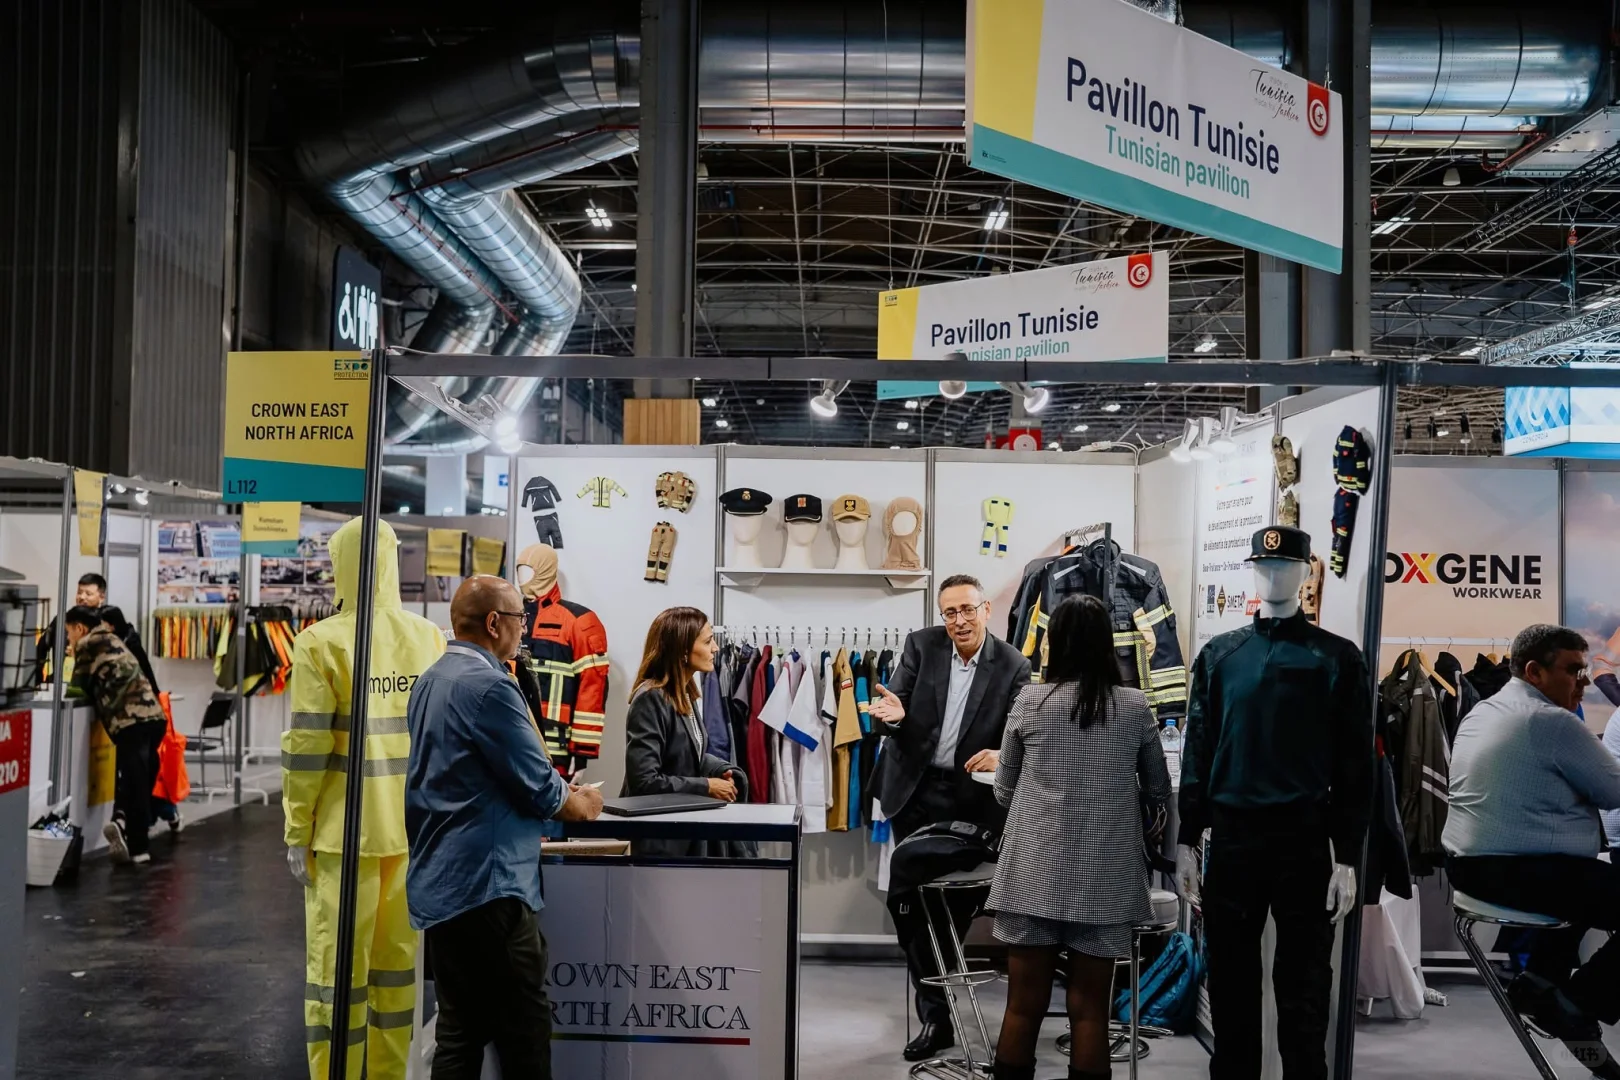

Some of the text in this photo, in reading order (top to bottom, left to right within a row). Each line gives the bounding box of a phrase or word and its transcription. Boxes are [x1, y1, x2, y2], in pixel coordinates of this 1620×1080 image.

[1249, 69, 1296, 107] Tunisia
[1066, 56, 1280, 175] Pavillon Tunisie
[1105, 124, 1250, 199] Tunisian pavilion
[1070, 267, 1116, 285] Tunisia
[931, 305, 1099, 347] Pavillon Tunisie
[1015, 338, 1070, 361] pavilion
[251, 403, 349, 418] CROWN EAST
[245, 425, 354, 440] NORTH AFRICA
[228, 480, 257, 494] L112
[1453, 587, 1542, 599] WORKWEAR
[649, 964, 736, 991] EAST
[620, 1003, 750, 1030] AFRICA
